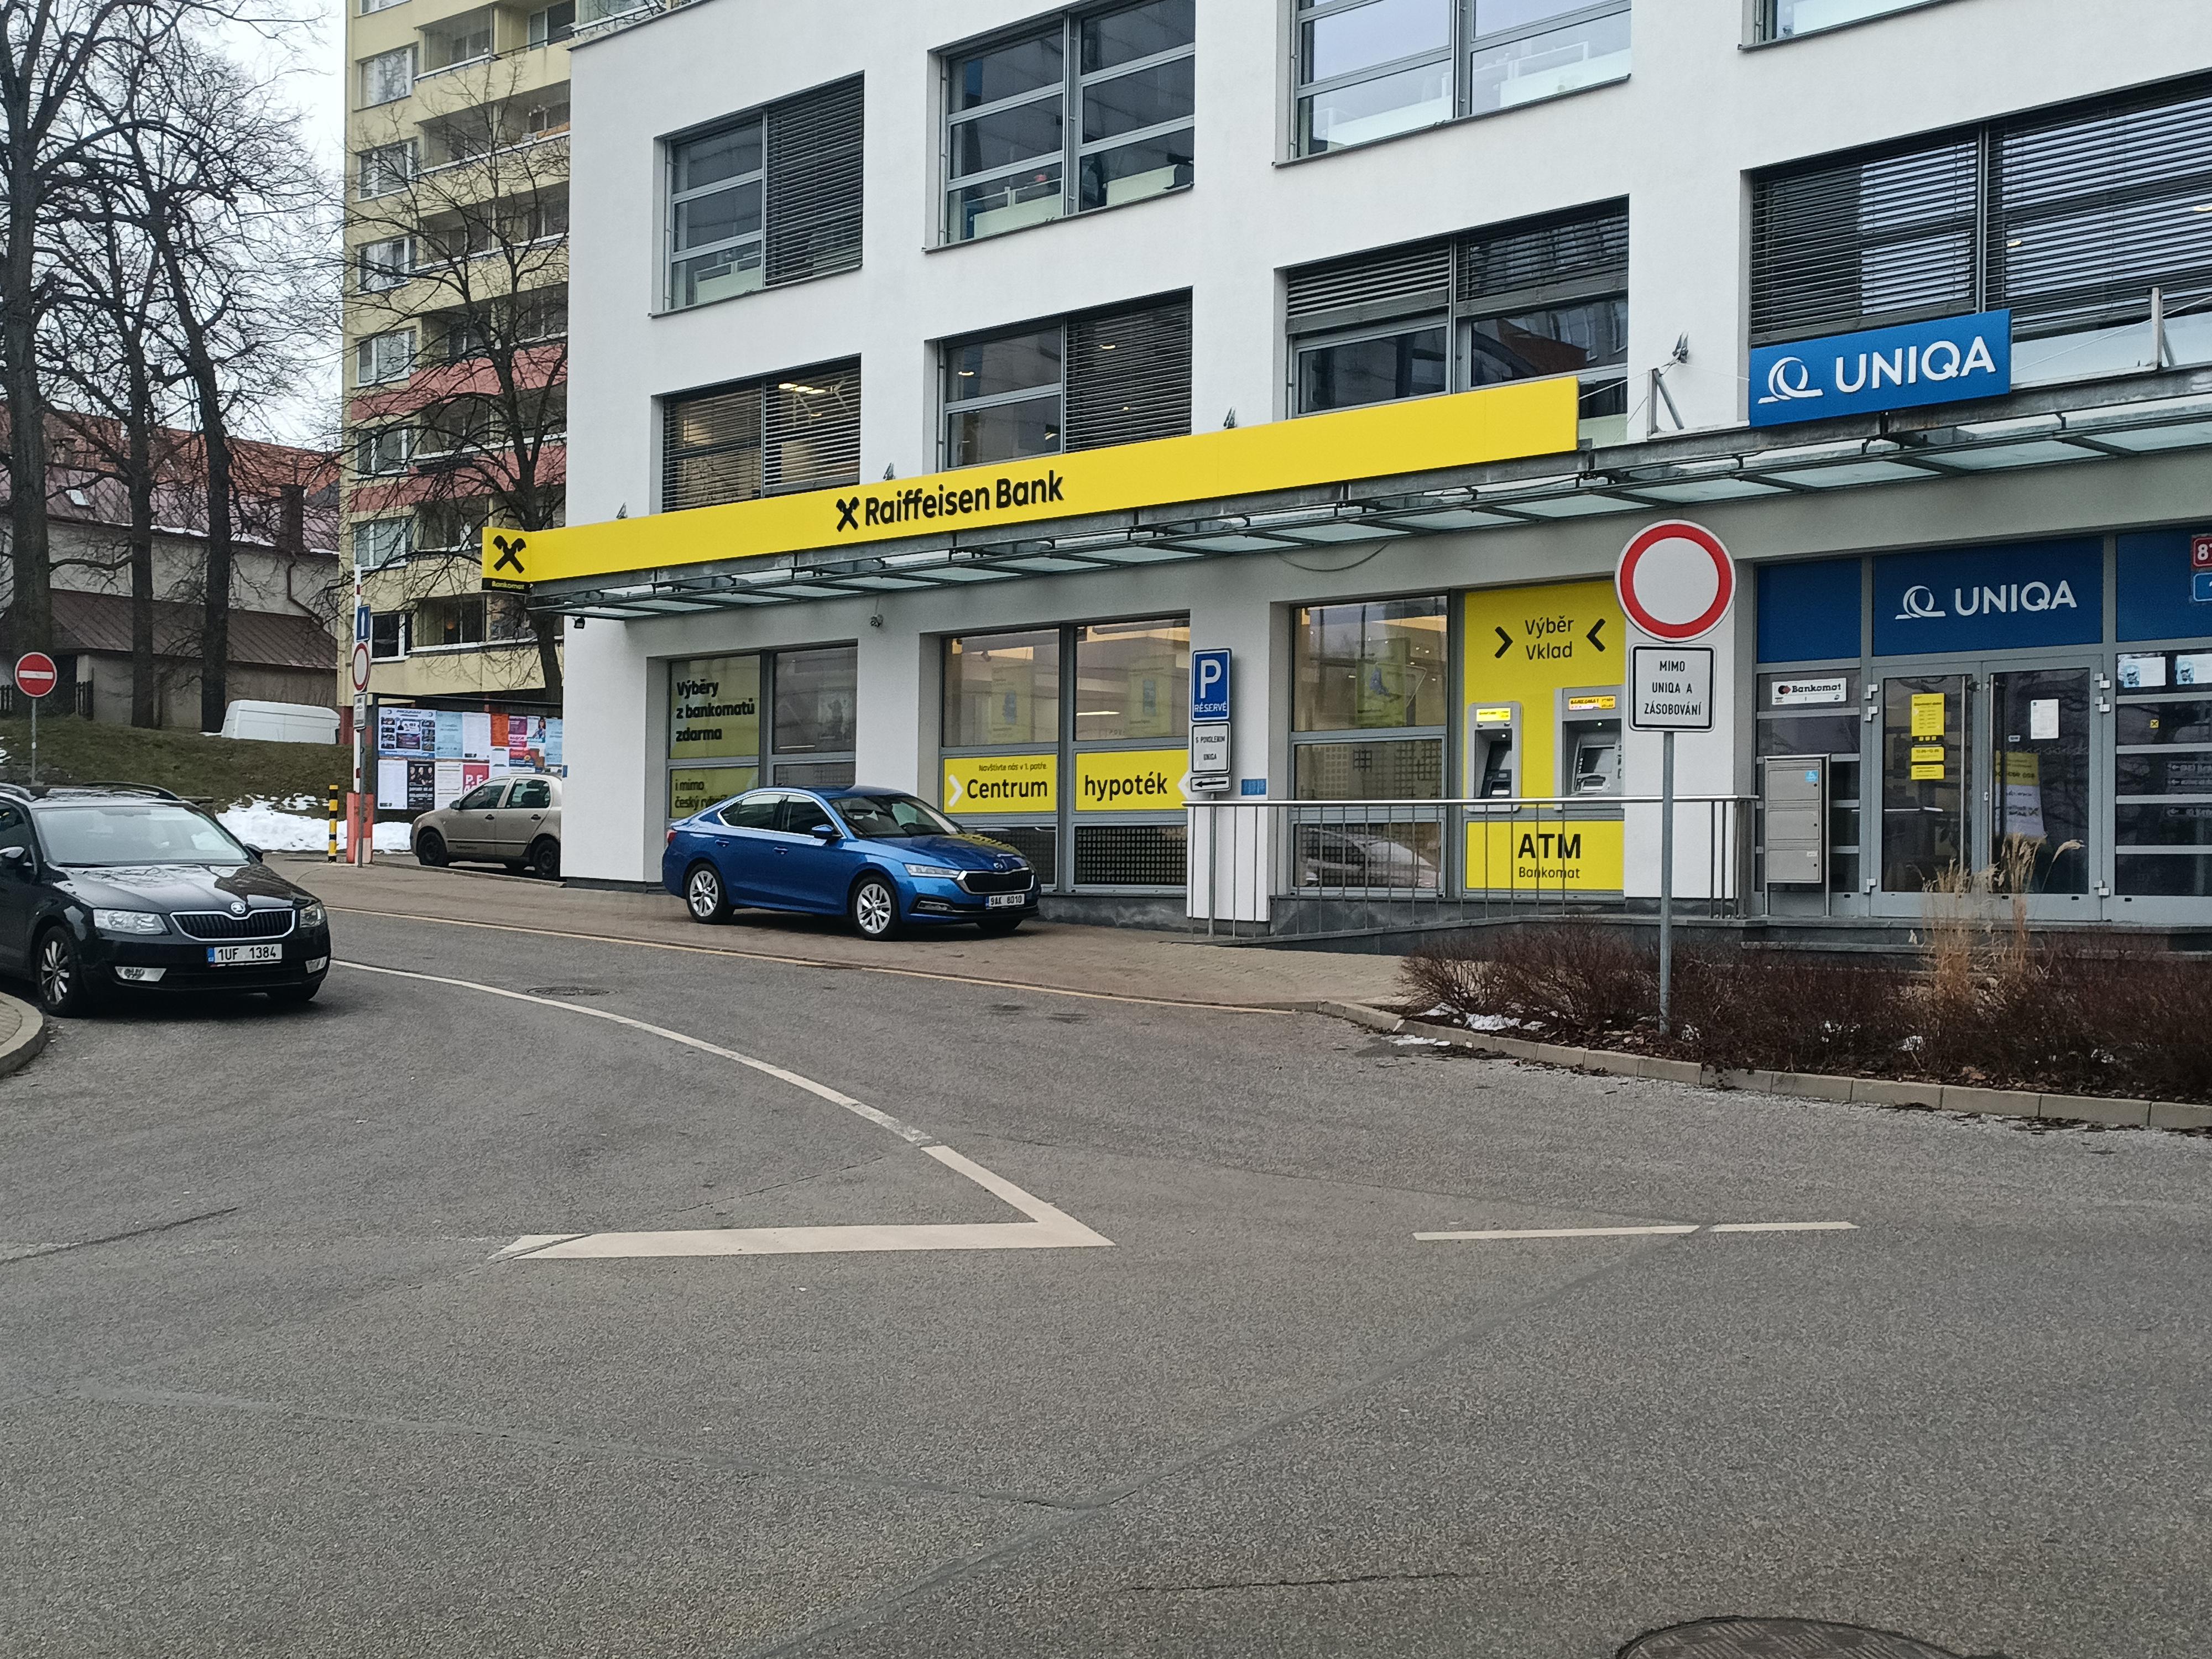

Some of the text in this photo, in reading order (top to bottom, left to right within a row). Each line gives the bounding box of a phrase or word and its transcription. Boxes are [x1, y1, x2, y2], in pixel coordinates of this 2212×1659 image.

[1835, 336, 1996, 393] UNIQA
[865, 469, 1065, 526] Raiffeisen Bank
[2198, 544, 2212, 560] 8
[1955, 580, 2078, 616] UNIQA
[1525, 615, 1574, 639] Výběr
[1526, 641, 1572, 660] Vklad
[1659, 660, 1685, 672] MIMO
[1199, 659, 1222, 699] P
[1652, 681, 1693, 693] UNIQA A
[676, 679, 719, 699] Výběry
[1792, 683, 1841, 693] Bankomat
[676, 697, 755, 719] z bankomatů
[1194, 700, 1227, 712] RÉSERVÉ
[1644, 700, 1702, 716] ZÁSOBOVÁNÍ
[676, 727, 722, 742] zdarma
[680, 779, 705, 791] mimo
[967, 771, 1168, 801] Centrum hypoték
[1517, 833, 1581, 859] ATM
[1519, 866, 1580, 879] Bankomat
[218, 946, 276, 961] 1UF 1384
